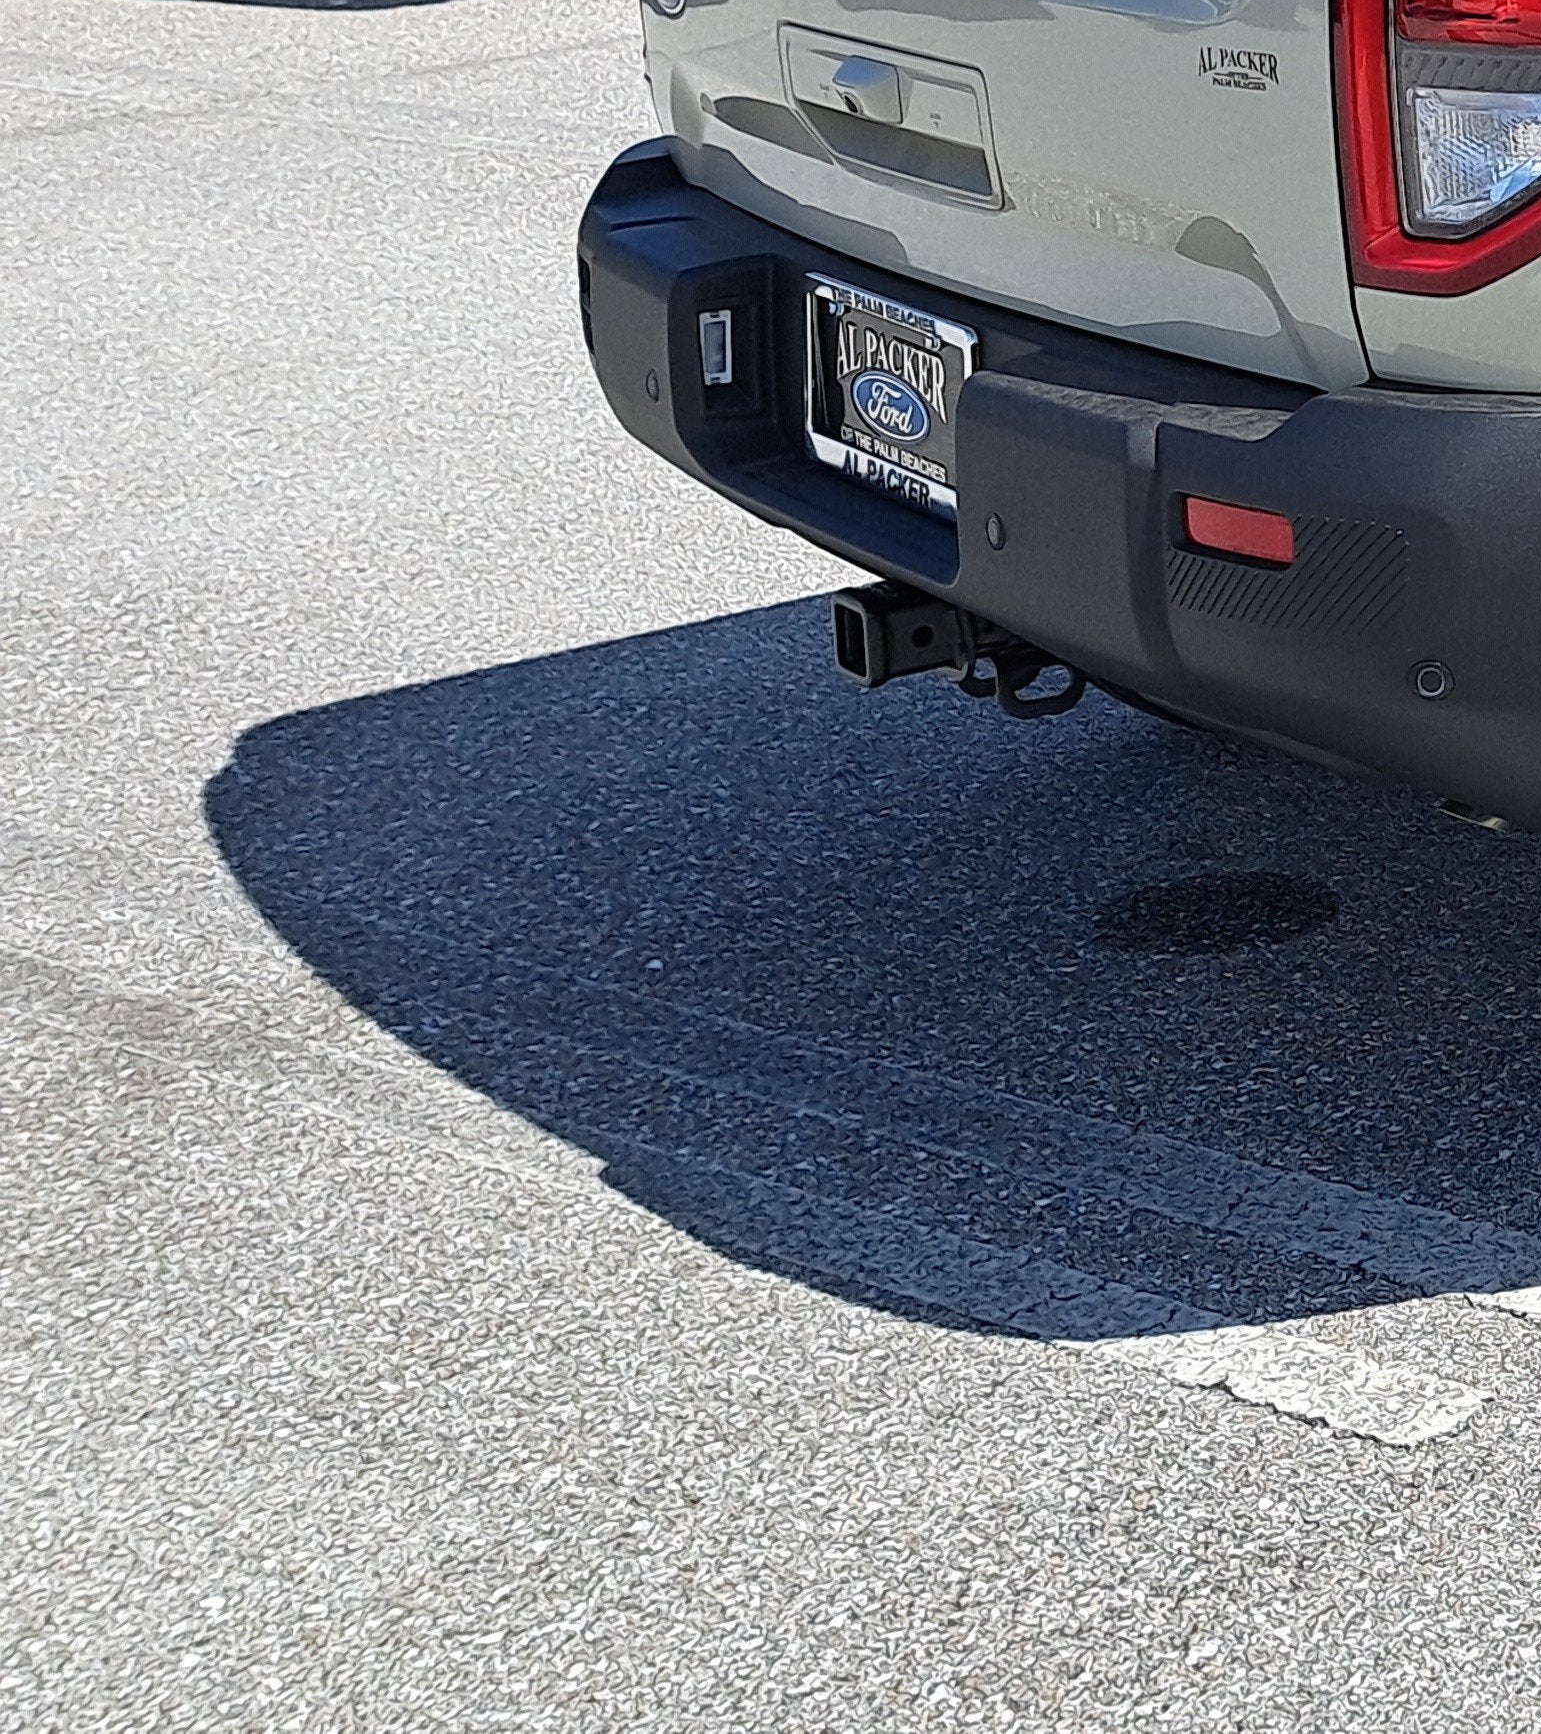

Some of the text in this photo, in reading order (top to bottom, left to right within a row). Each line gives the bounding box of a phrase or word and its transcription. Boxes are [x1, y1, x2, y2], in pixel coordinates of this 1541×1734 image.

[1198, 46, 1218, 78] AL
[1219, 47, 1280, 86] PACKER
[853, 292, 884, 313] PALM
[836, 320, 948, 425] AL PACKER
[867, 381, 913, 434] Ford
[855, 430, 874, 450] THE
[874, 437, 900, 463] PALM
[900, 446, 947, 483] BEACHES
[866, 458, 931, 509] PACKER
